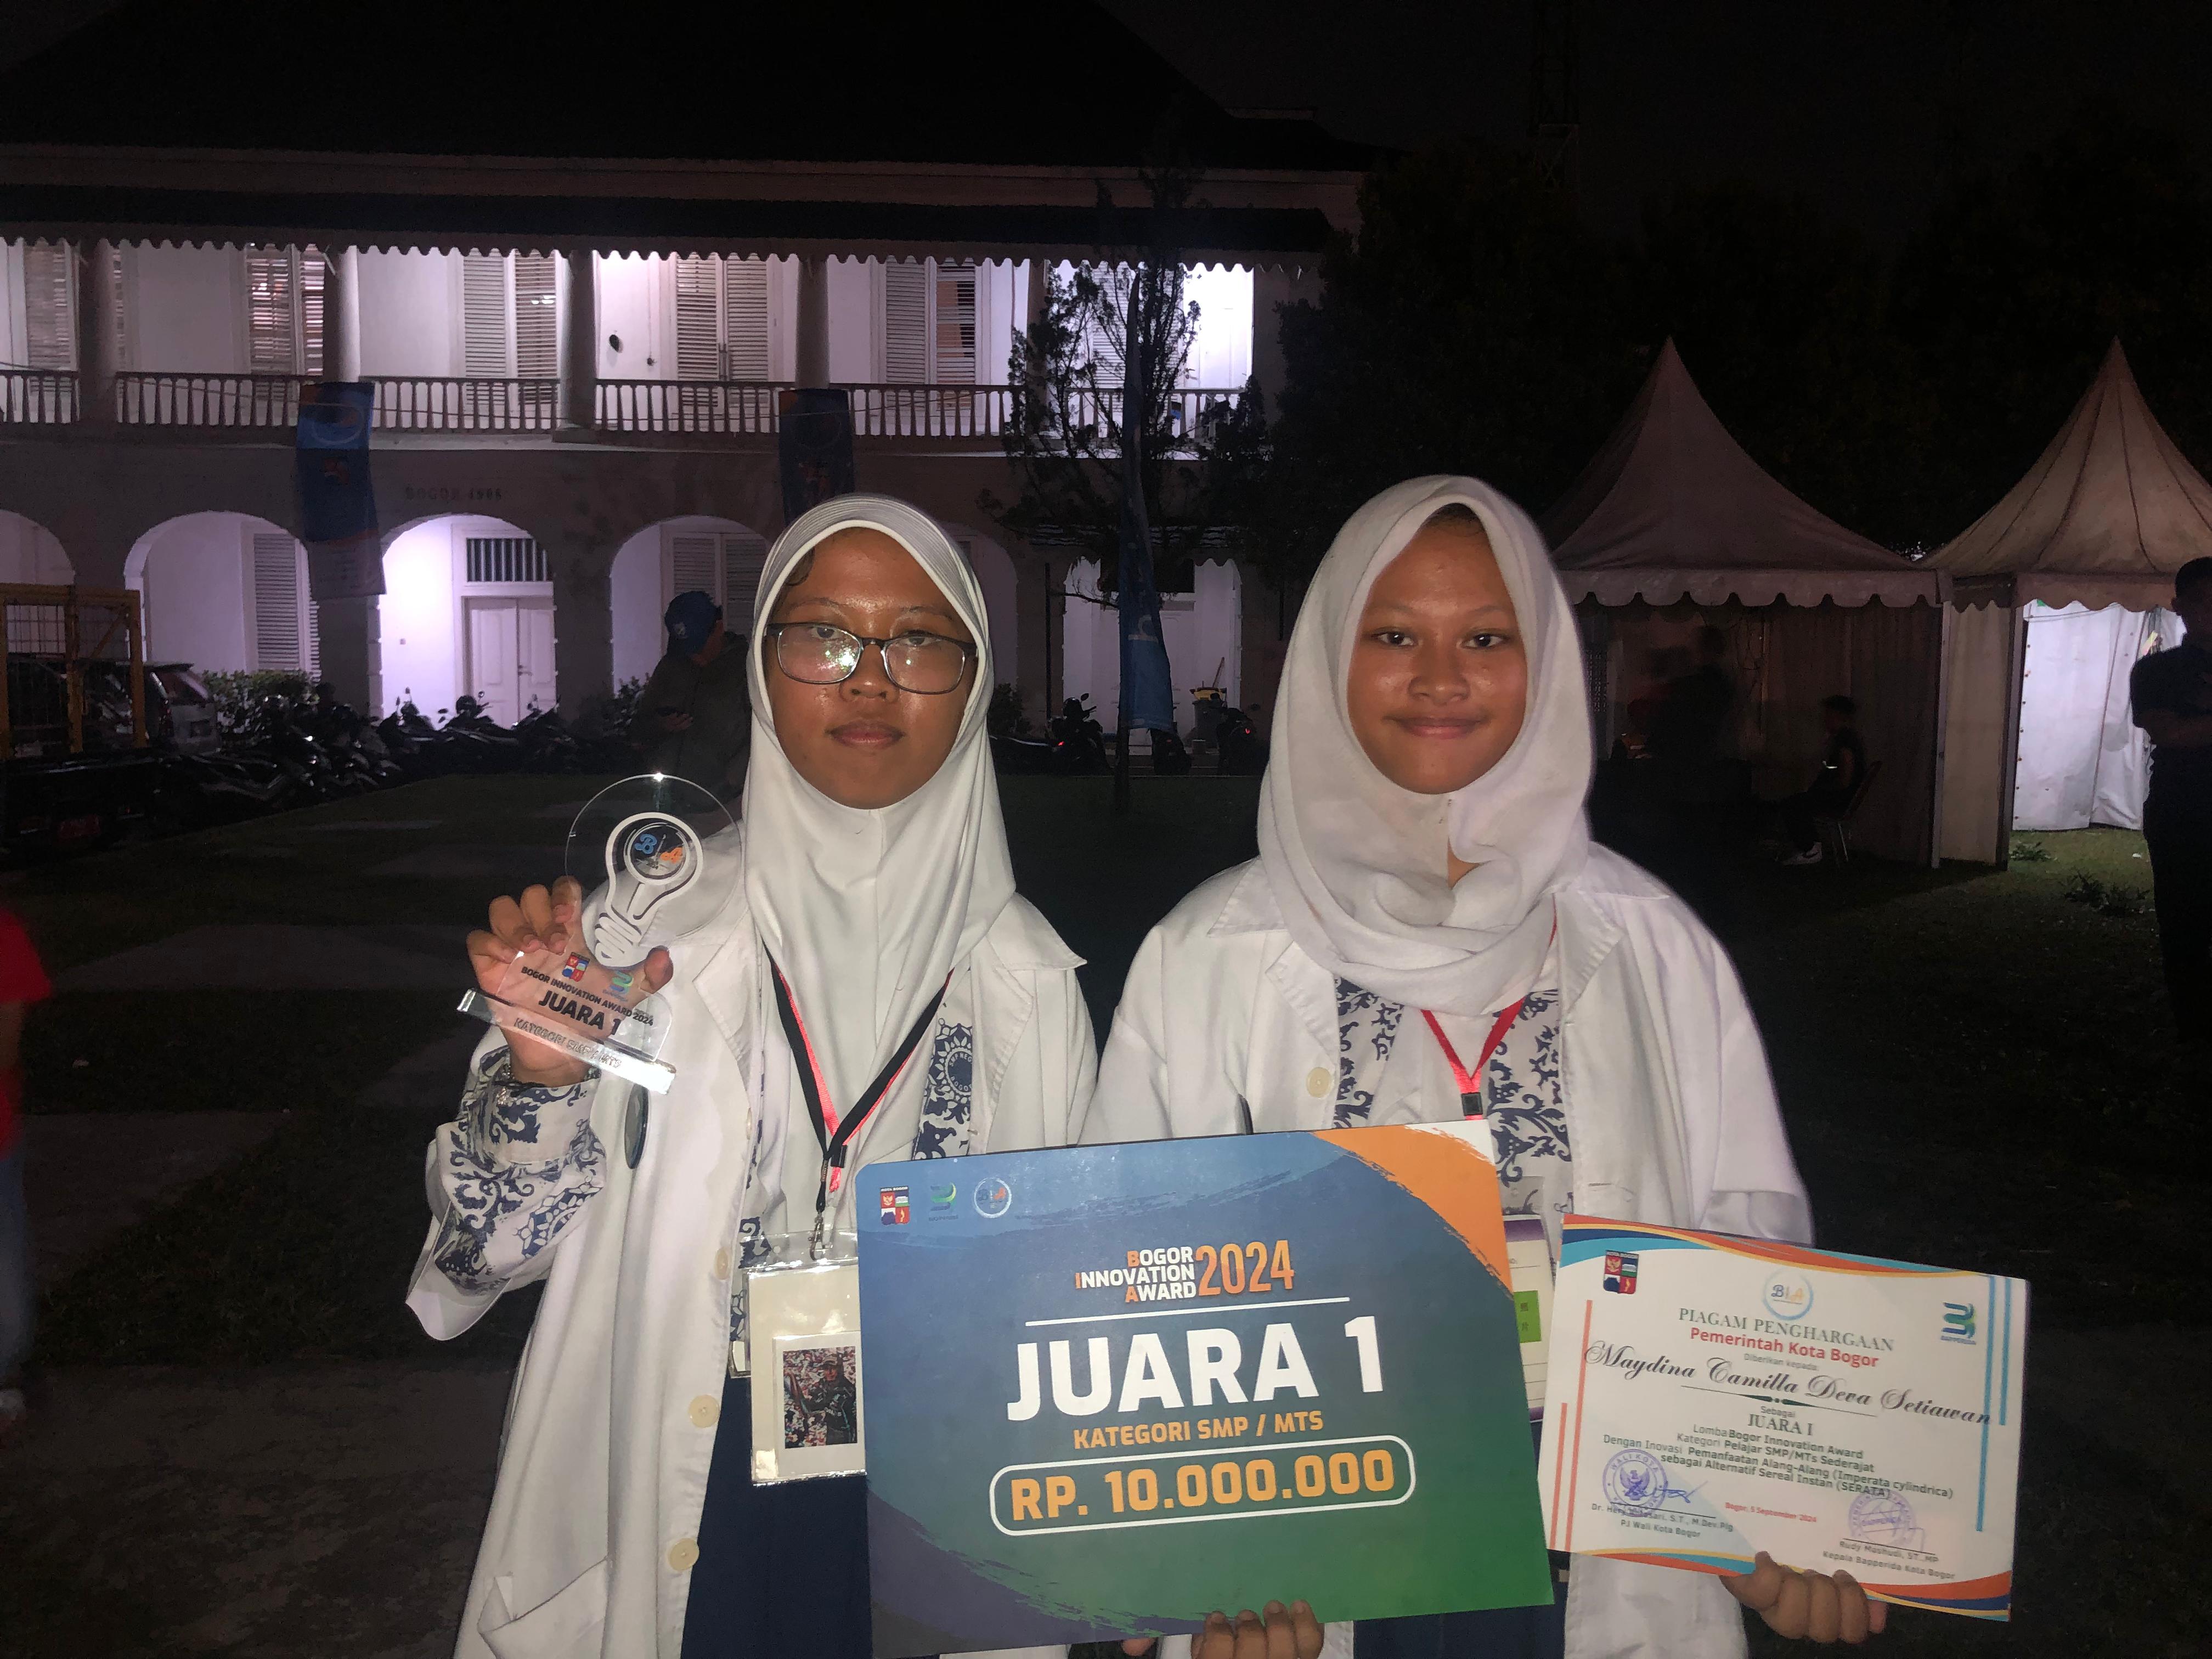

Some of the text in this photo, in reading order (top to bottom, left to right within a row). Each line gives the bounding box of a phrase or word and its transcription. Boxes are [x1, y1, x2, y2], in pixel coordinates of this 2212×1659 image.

[521, 966, 550, 984] BOGOR
[550, 978, 602, 1005] INNOVATION
[601, 1000, 633, 1017] AWARD
[632, 1014, 653, 1026] 2024
[539, 990, 605, 1030] JUARA
[610, 1018, 622, 1036] 1
[1075, 1264, 1195, 1289] INNOVATION
[1127, 1246, 1194, 1267] BOGOR
[1195, 1239, 1295, 1297] 2024
[1125, 1281, 1197, 1304] AWARD
[1679, 1308, 1894, 1351] PIAGAM PENGHARGAAN
[1690, 1327, 1879, 1368] Pemerintah Kota Bogor
[1007, 1316, 1384, 1421] JUARA 1
[1584, 1340, 1696, 1380] Maydina
[1706, 1357, 1799, 1394] Camilla
[1880, 1388, 1991, 1425] Setiawan
[1073, 1410, 1324, 1449] KATEGORI SMP / MTS
[1747, 1413, 1814, 1436] JUARA I
[1760, 1406, 1796, 1419] Sebagai
[1677, 1432, 1875, 1473] Kategori Pelajar SMP/MTs Sederajat
[1693, 1424, 1864, 1459] Lomba Bogor Innovation Award
[1011, 1449, 1395, 1521] RP. 10.000.000
[1603, 1434, 1954, 1499] Dengan Inovasi Pemanfaatan Alang-Alang (Imperata cylindrica)
[1660, 1453, 1702, 1468] sebagai
[1705, 1459, 1757, 1475] Alternatif
[1759, 1468, 1794, 1482] Sereal
[1797, 1474, 1833, 1488] Instan
